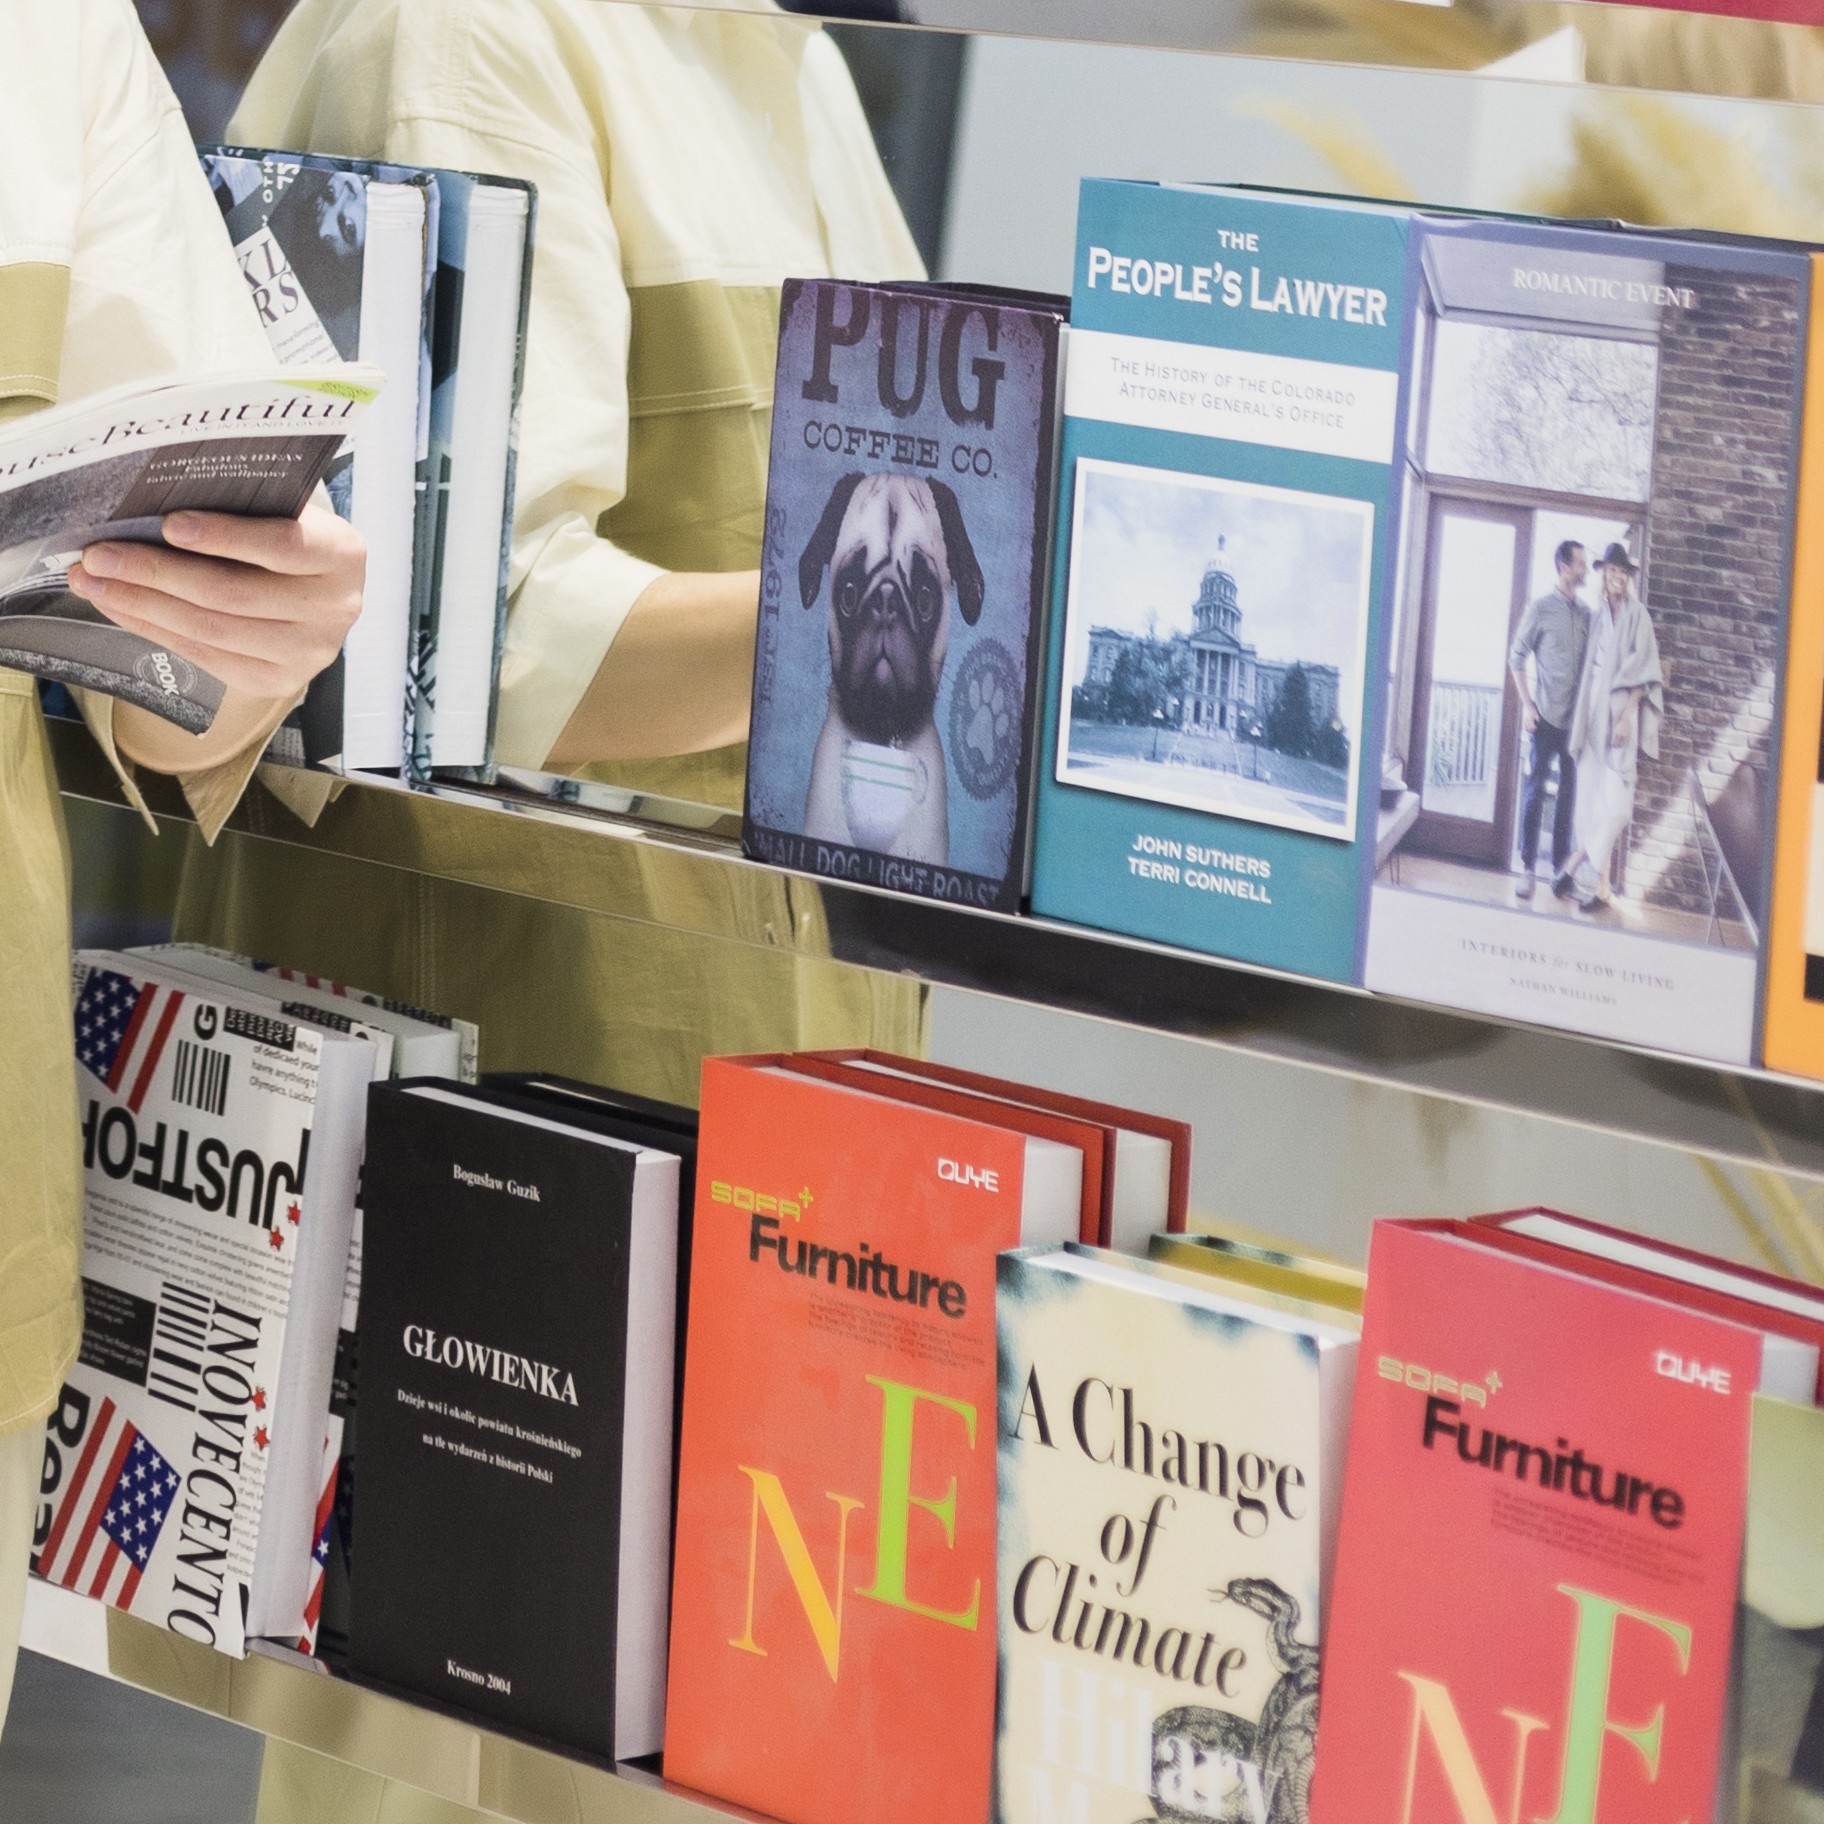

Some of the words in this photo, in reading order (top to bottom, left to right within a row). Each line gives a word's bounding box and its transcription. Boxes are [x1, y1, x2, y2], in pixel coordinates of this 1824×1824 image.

[1216, 228, 1260, 253] THE
[1087, 245, 1243, 308] PEOPLE'S
[1250, 266, 1387, 326] LAWYER
[1513, 267, 1621, 300] ROMANTIC
[1625, 278, 1695, 310] EVENT
[800, 283, 1006, 432] PUG
[1111, 356, 1140, 376] THE
[1144, 362, 1208, 385] HISTORY
[1214, 373, 1233, 388] OF
[1239, 377, 1266, 393] THE
[1271, 379, 1357, 407] COLORADO
[1118, 381, 1197, 406] ATTORNEY
[1201, 392, 1285, 421] GENERAL'S
[1289, 405, 1345, 430] OFFICE
[802, 420, 941, 470] COFFEE
[950, 439, 999, 478] CO.
[150, 652, 180, 696] BOOK
[1128, 856, 1182, 883] TERRI
[1184, 867, 1273, 905] CONNELL
[1131, 833, 1180, 860] JOHN
[1184, 841, 1272, 878] SUTHERS
[1460, 938, 1547, 964] INTERIORS
[1575, 962, 1616, 978] SLOW
[1622, 971, 1675, 991] LIVING
[1510, 977, 1556, 994] NATHAN
[1560, 986, 1618, 1005] WILLIAMS
[507, 1179, 541, 1202] Guzik
[749, 1213, 967, 1320] Furniture
[402, 1324, 580, 1407] GŁOWIENKA
[397, 1388, 426, 1410] Dzieje
[449, 1404, 476, 1424] okolic
[478, 1415, 514, 1437] powiatu
[527, 1464, 554, 1484] Polski
[1009, 1362, 1059, 1451] A
[1070, 1376, 1308, 1538] Change
[1421, 1393, 1687, 1531] Furniture
[1099, 1494, 1176, 1597] of
[1011, 1553, 1248, 1699] Climate
[446, 1658, 485, 1688] Krosno
[486, 1672, 512, 1697] 2004
